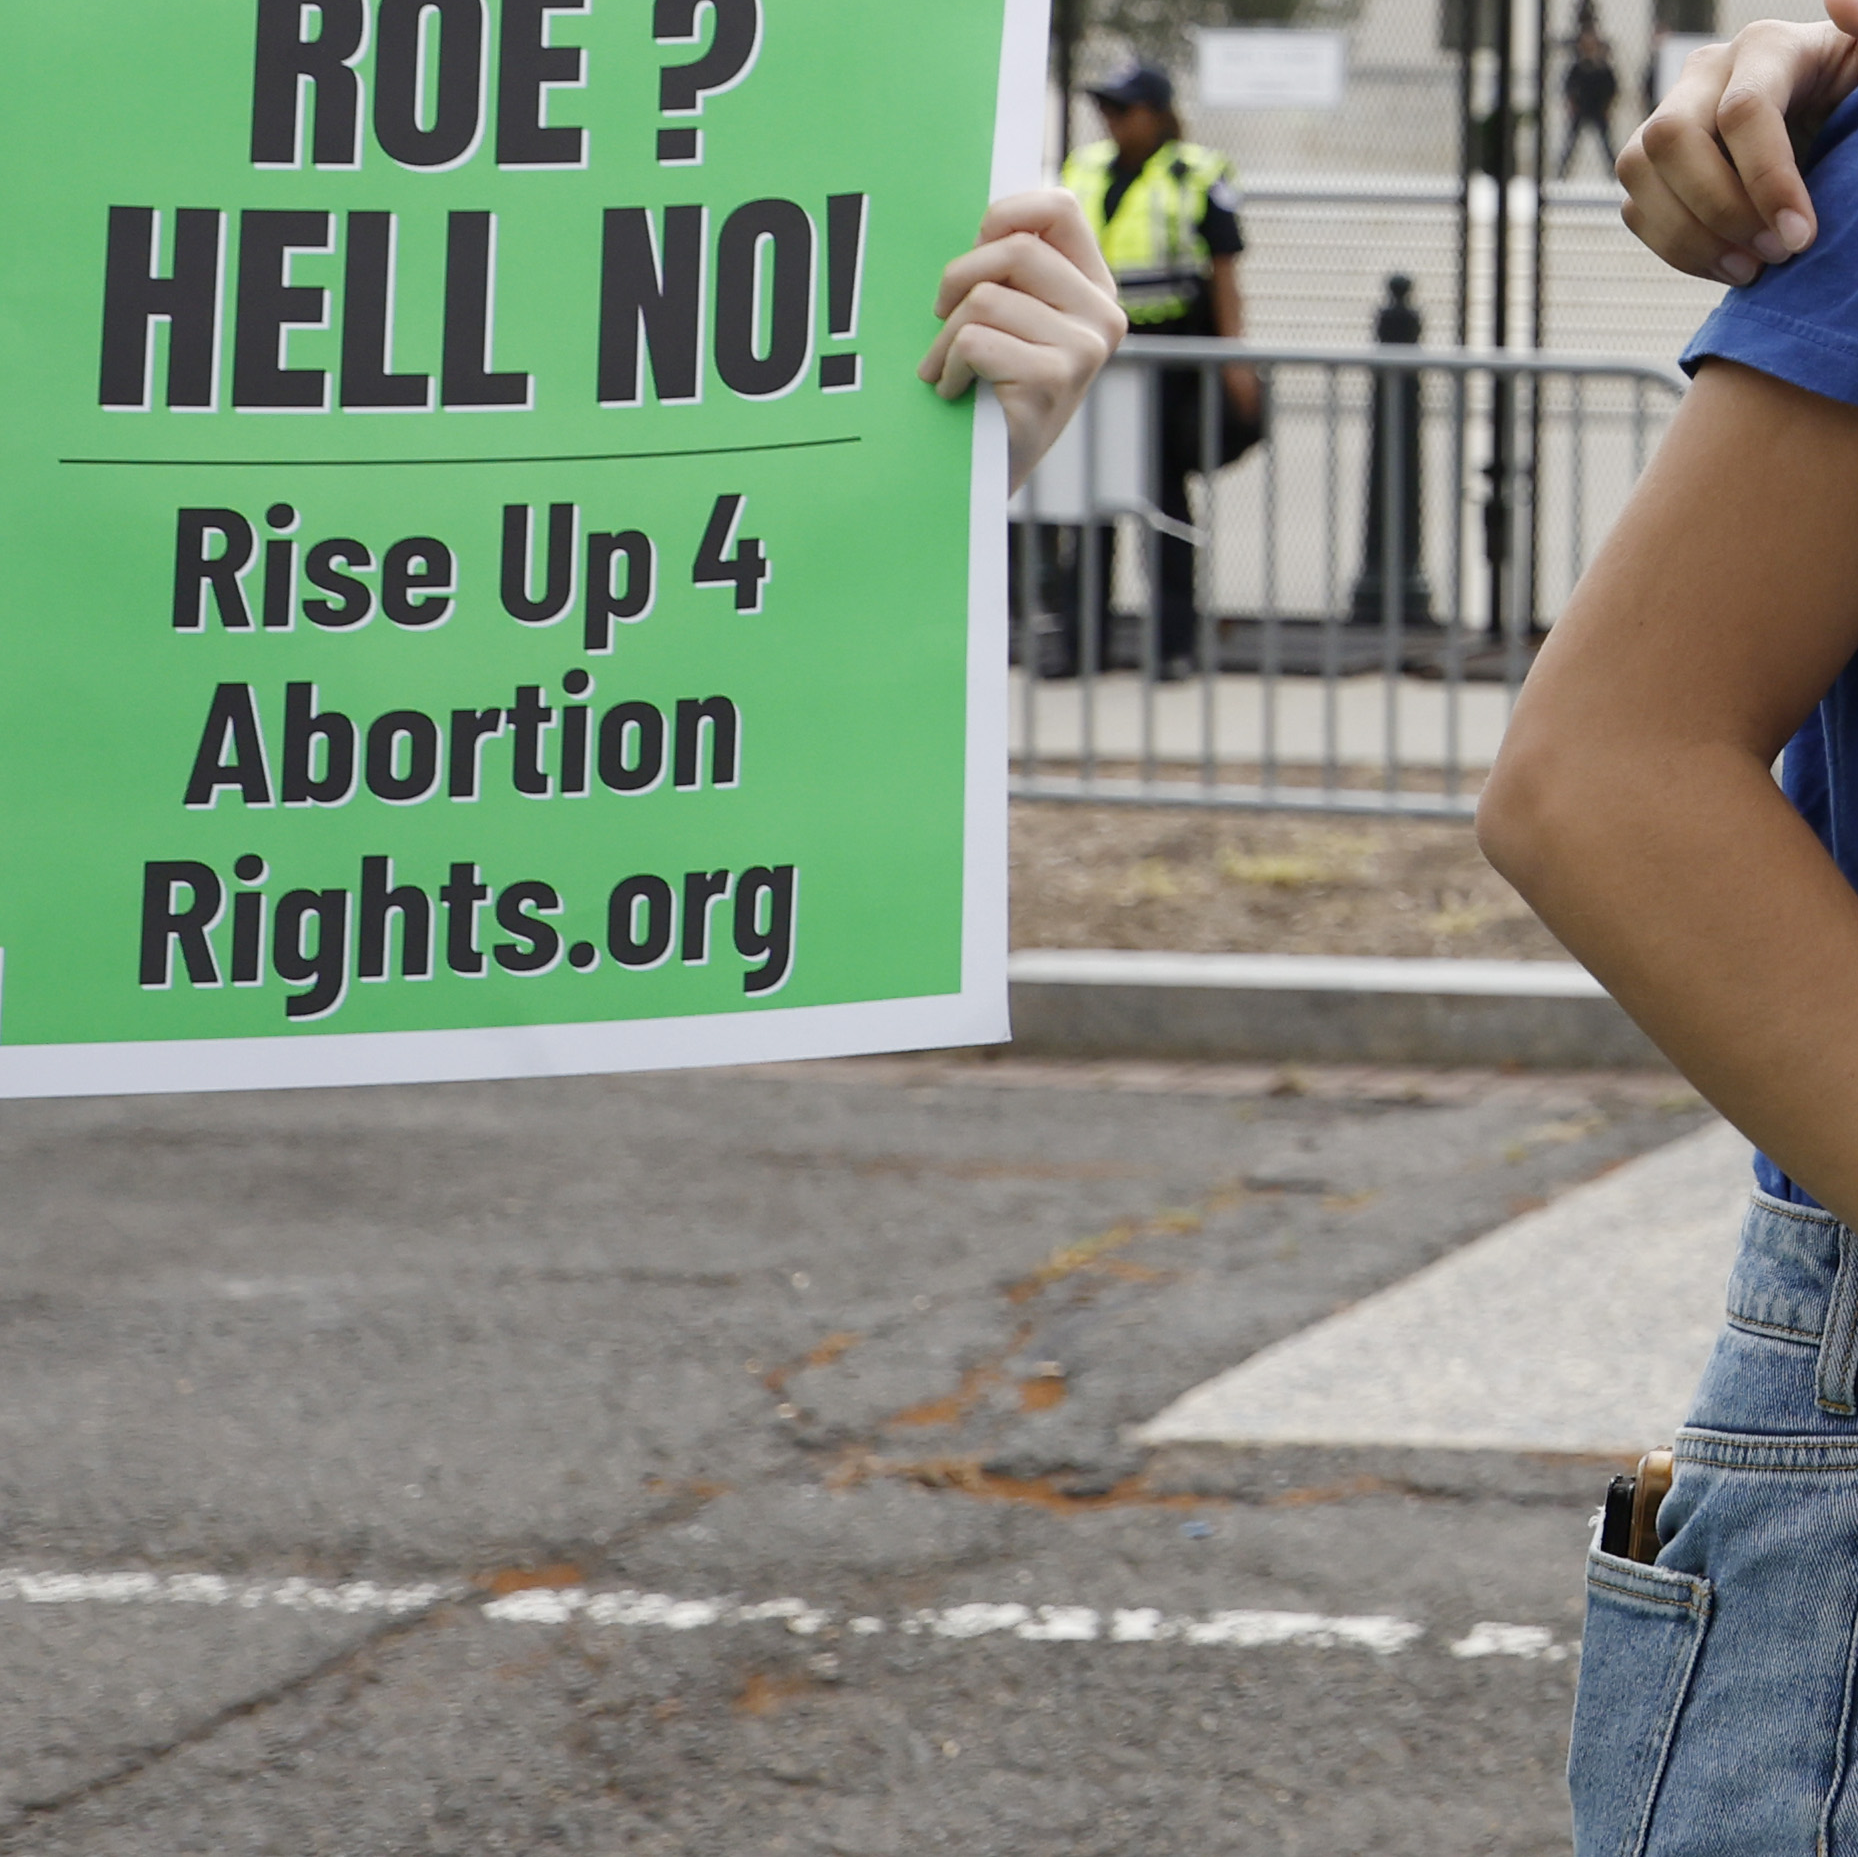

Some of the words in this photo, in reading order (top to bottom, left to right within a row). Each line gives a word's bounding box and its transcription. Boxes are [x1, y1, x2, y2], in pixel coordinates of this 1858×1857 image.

[98, 204, 534, 413] HELL
[597, 191, 868, 406] NO!
[172, 502, 457, 632] Rise
[499, 501, 655, 654] Up
[692, 493, 770, 615] 4
[183, 667, 741, 808] Abortion
[138, 853, 799, 1019] Rights.org
